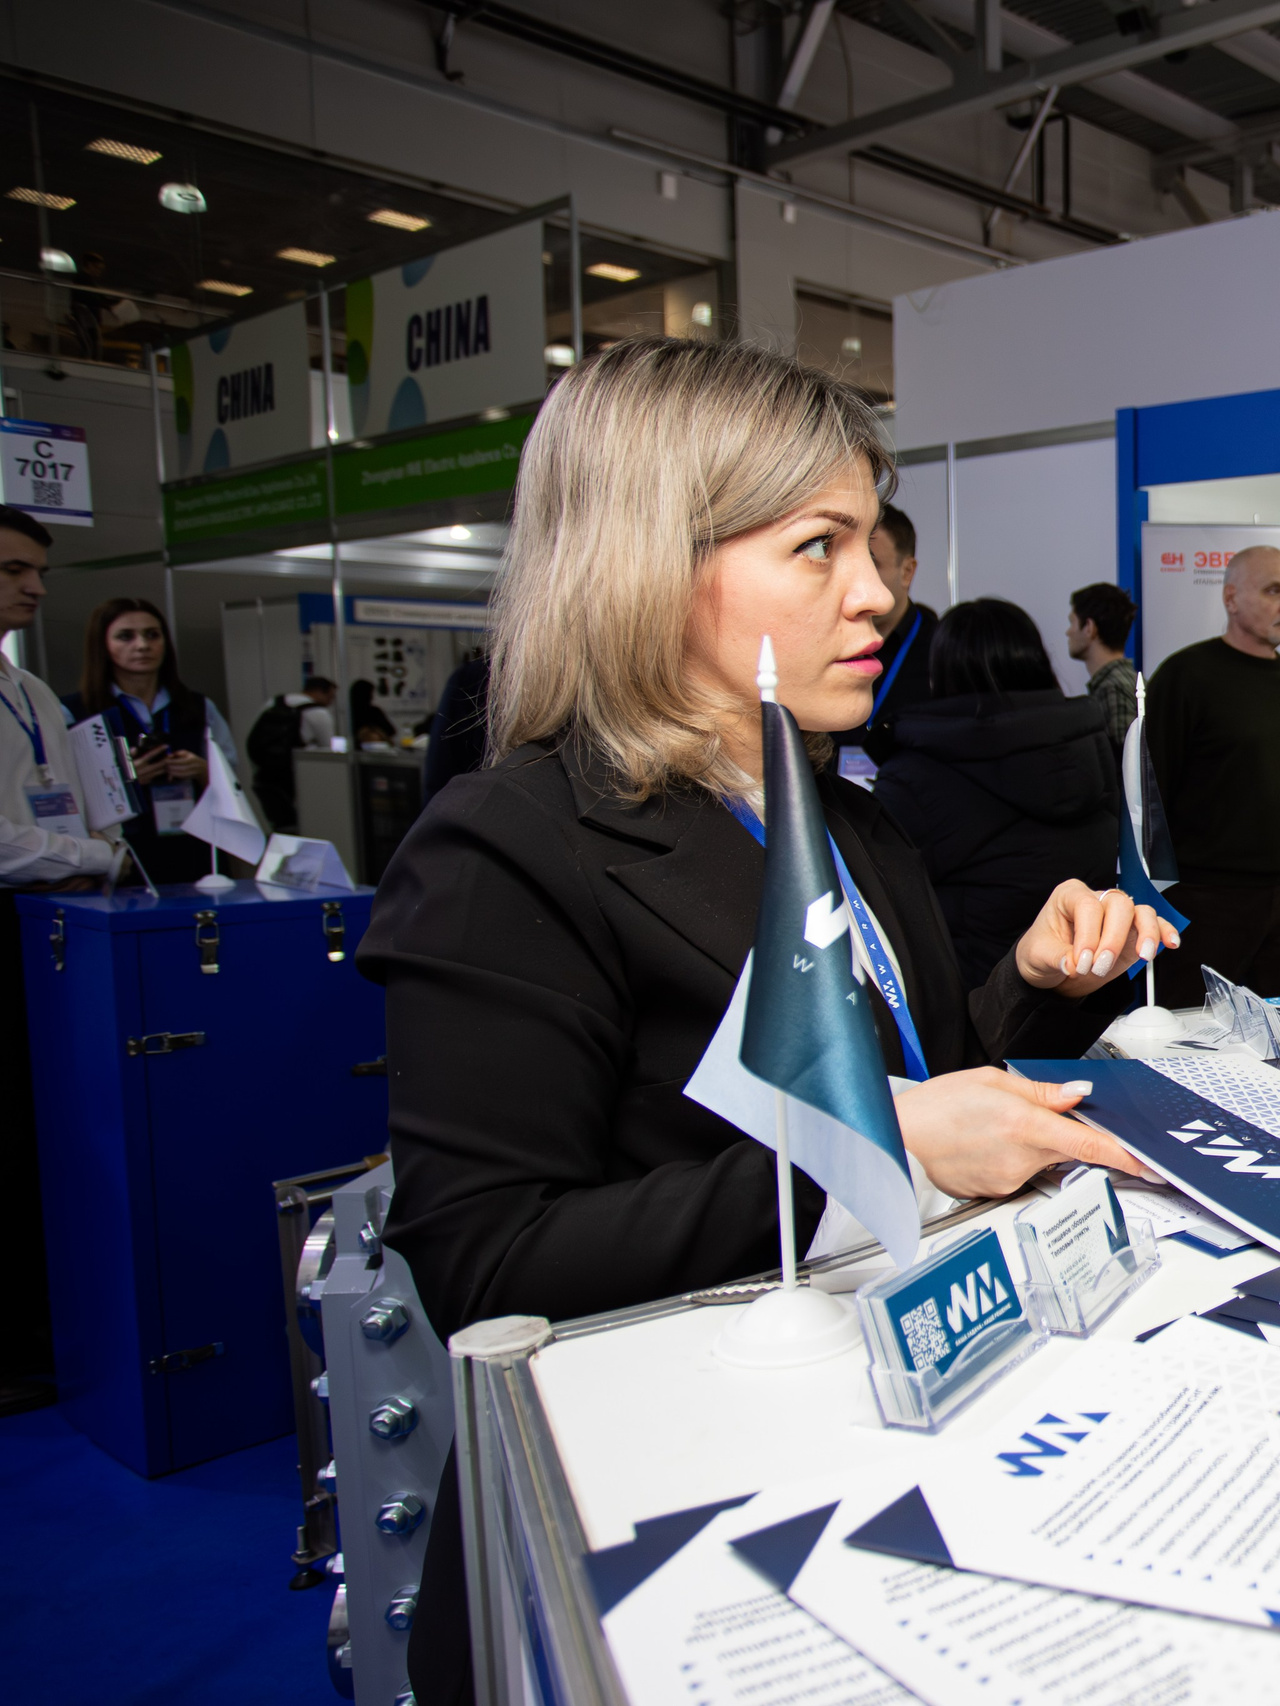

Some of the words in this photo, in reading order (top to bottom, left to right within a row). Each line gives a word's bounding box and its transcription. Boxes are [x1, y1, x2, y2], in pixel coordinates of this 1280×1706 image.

[407, 294, 491, 372] CHINA
[217, 363, 275, 425] CHINA
[15, 457, 75, 481] 7017
[1042, 1209, 1078, 1238] Теплообменное
[1050, 1238, 1074, 1259] Тепловые
[1074, 1225, 1090, 1242] пункты
[1051, 1227, 1072, 1247] пищевое
[1071, 1203, 1101, 1230] оборудование
